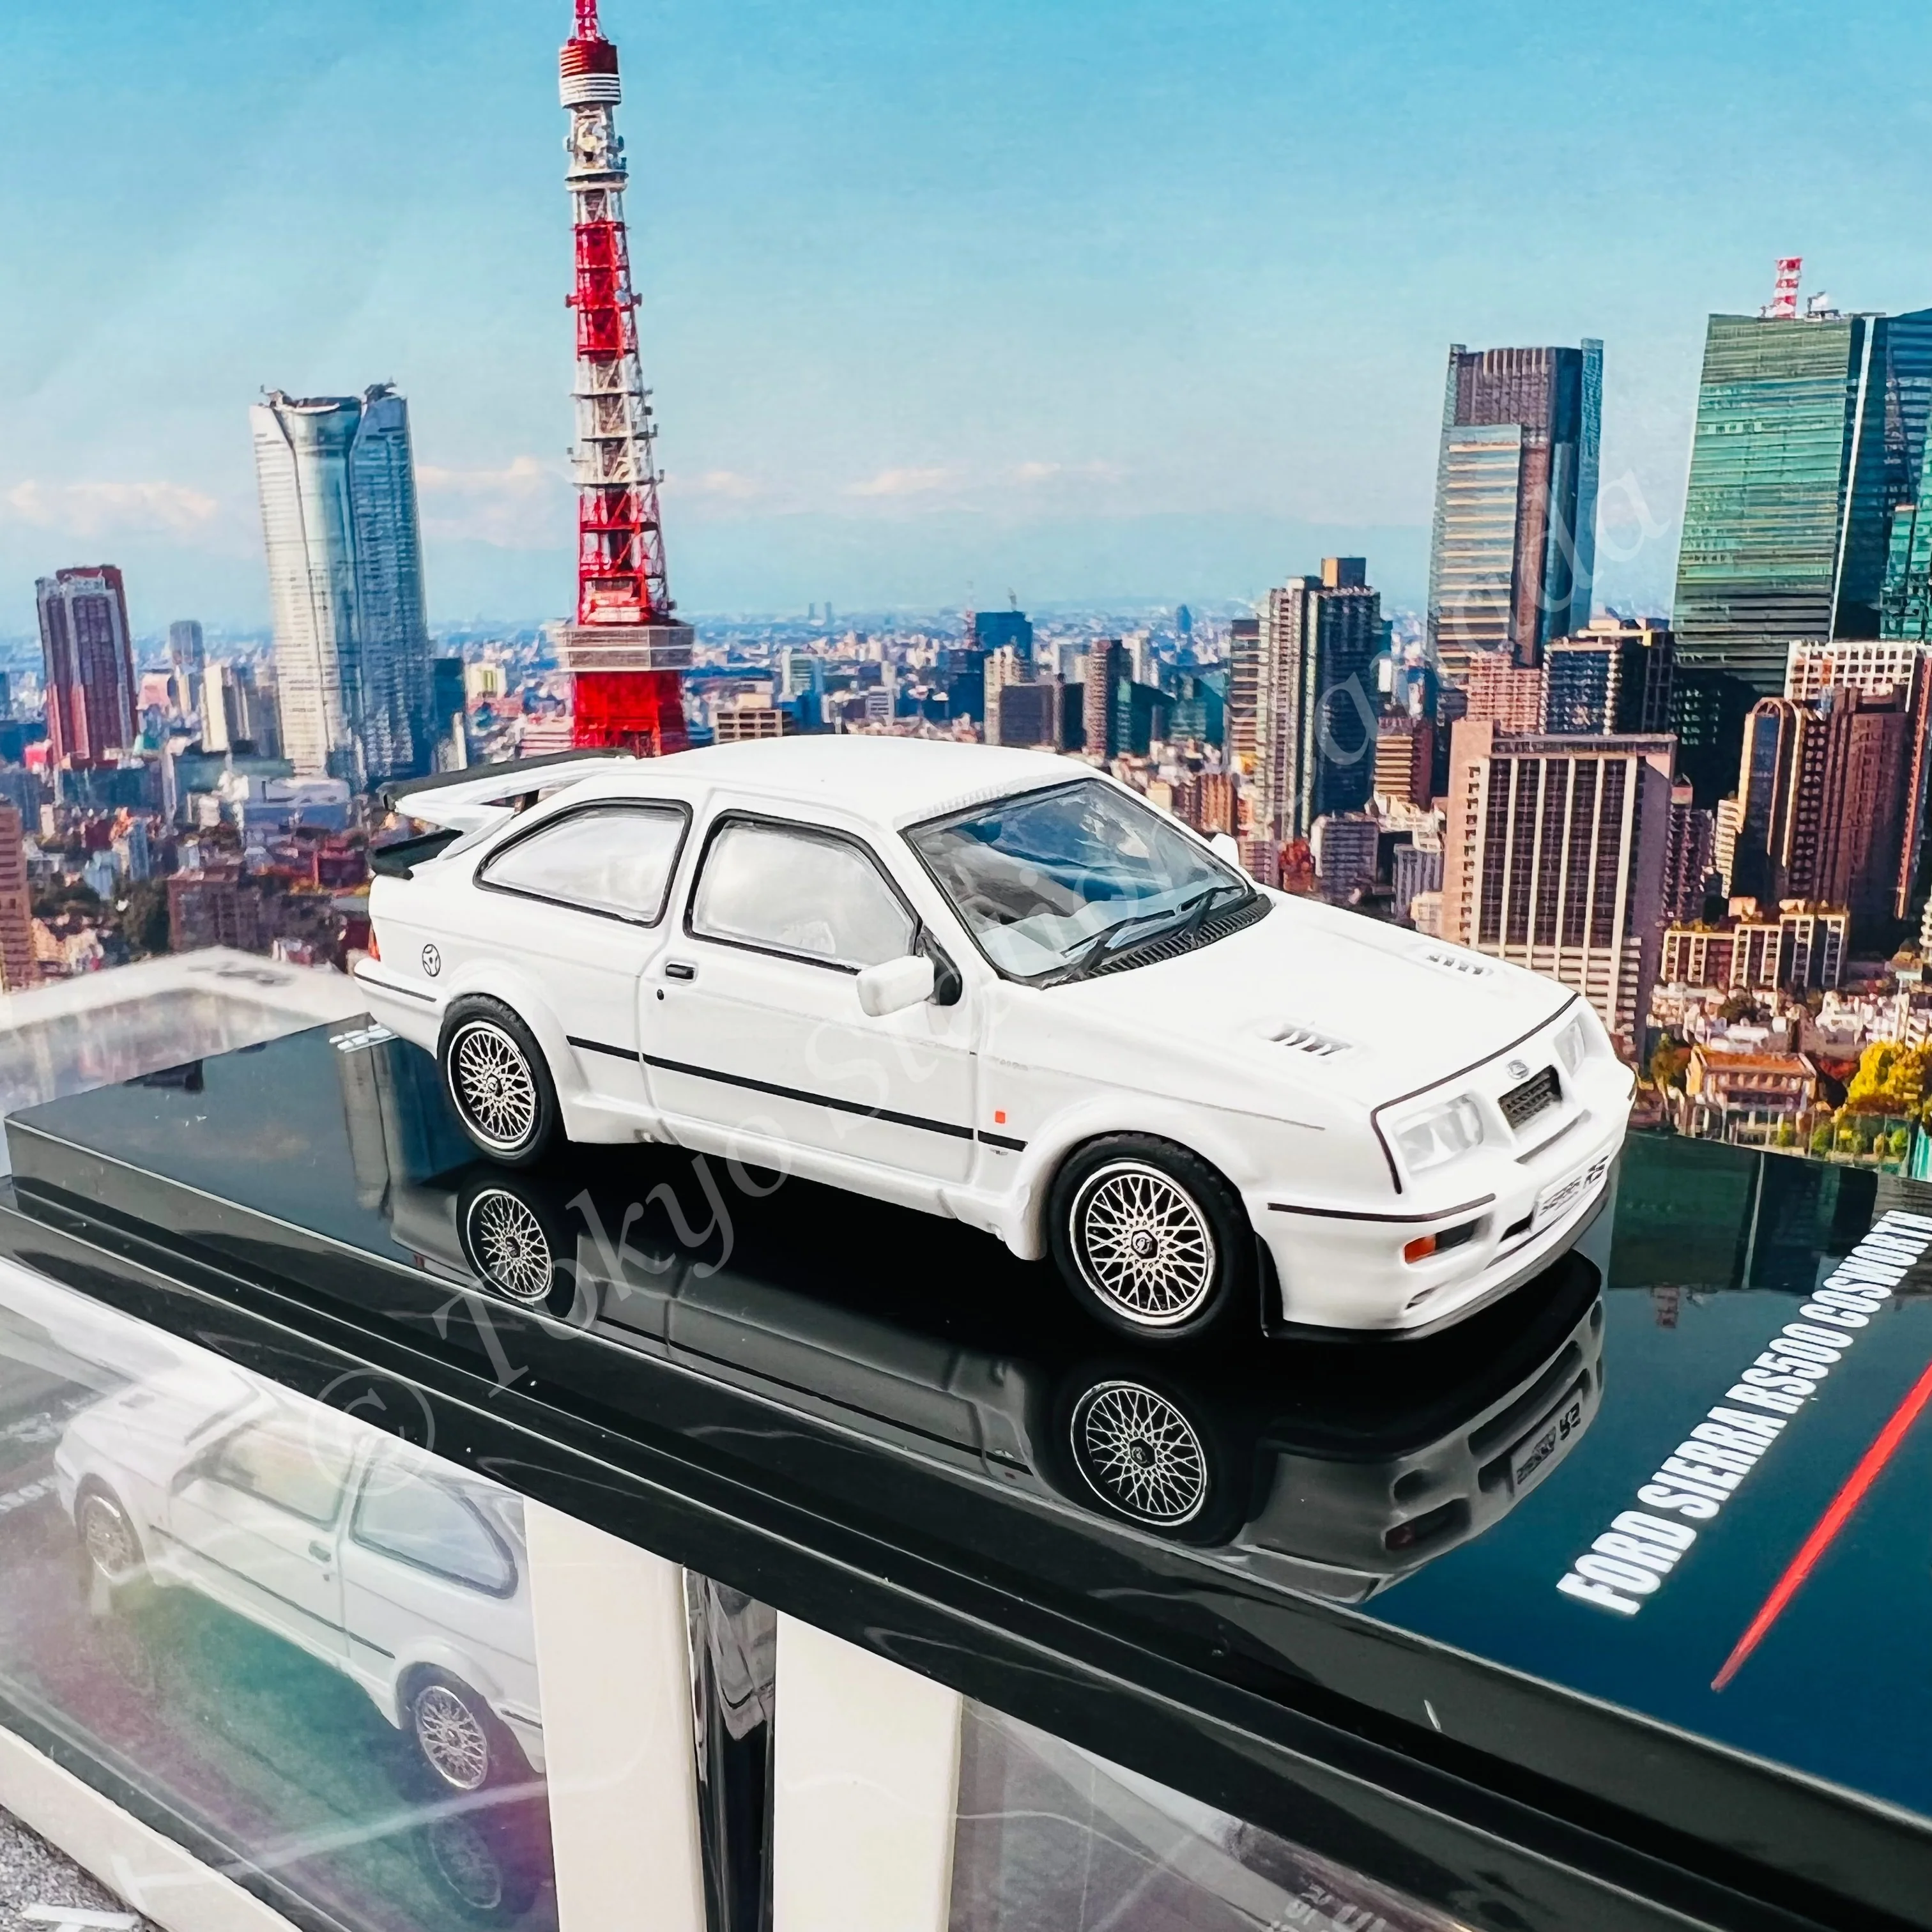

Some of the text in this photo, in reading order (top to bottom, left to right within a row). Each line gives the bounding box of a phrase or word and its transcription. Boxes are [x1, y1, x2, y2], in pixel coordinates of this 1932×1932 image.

[1556, 1210, 1932, 1615] FORD SIERRA RS500 COSWORTH
